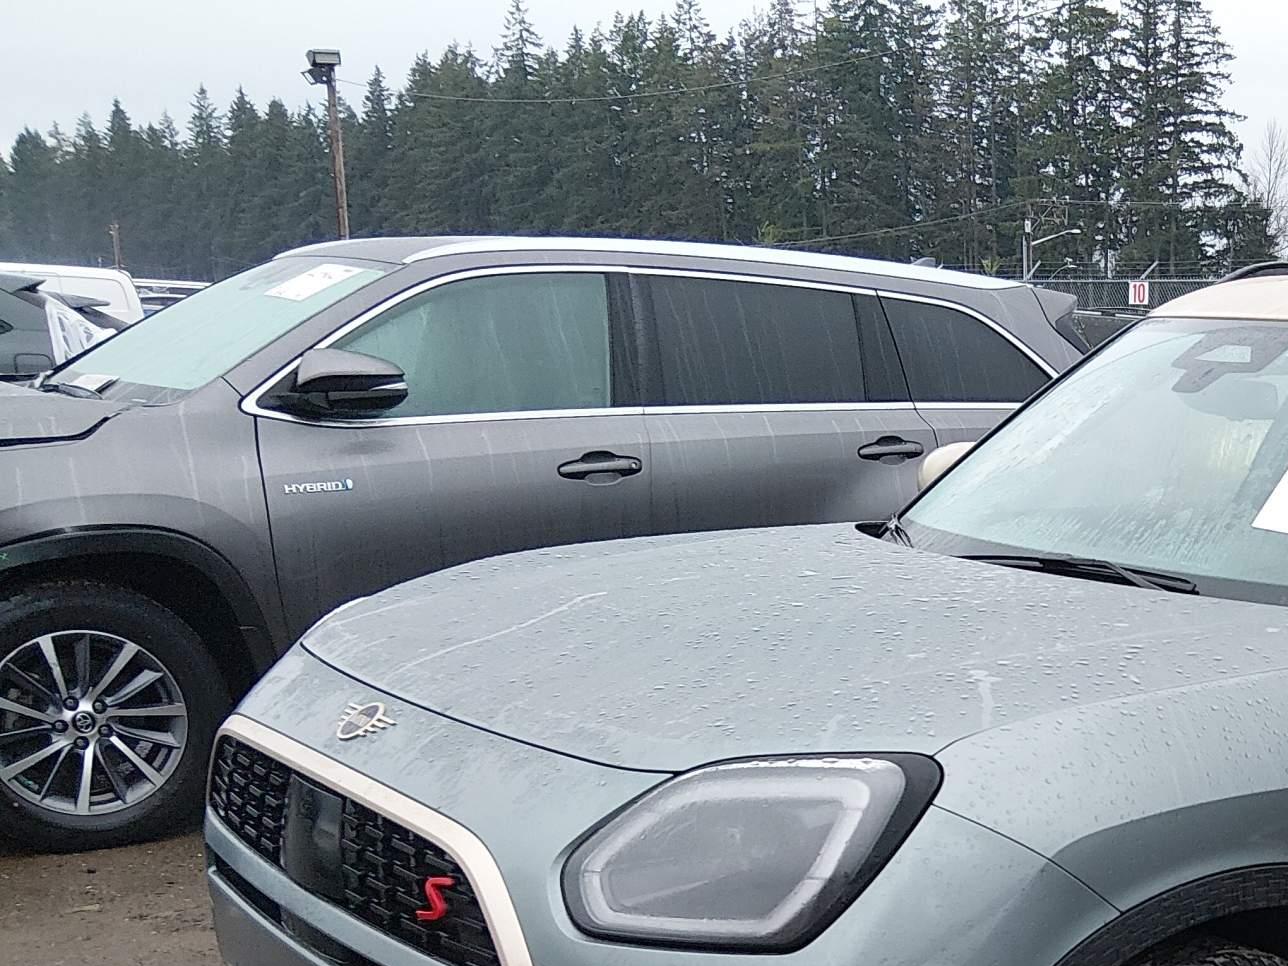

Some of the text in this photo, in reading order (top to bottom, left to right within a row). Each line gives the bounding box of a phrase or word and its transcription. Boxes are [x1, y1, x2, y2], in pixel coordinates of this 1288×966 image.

[1132, 283, 1146, 304] 10
[284, 481, 345, 494] HYBRID
[415, 877, 456, 921] S
